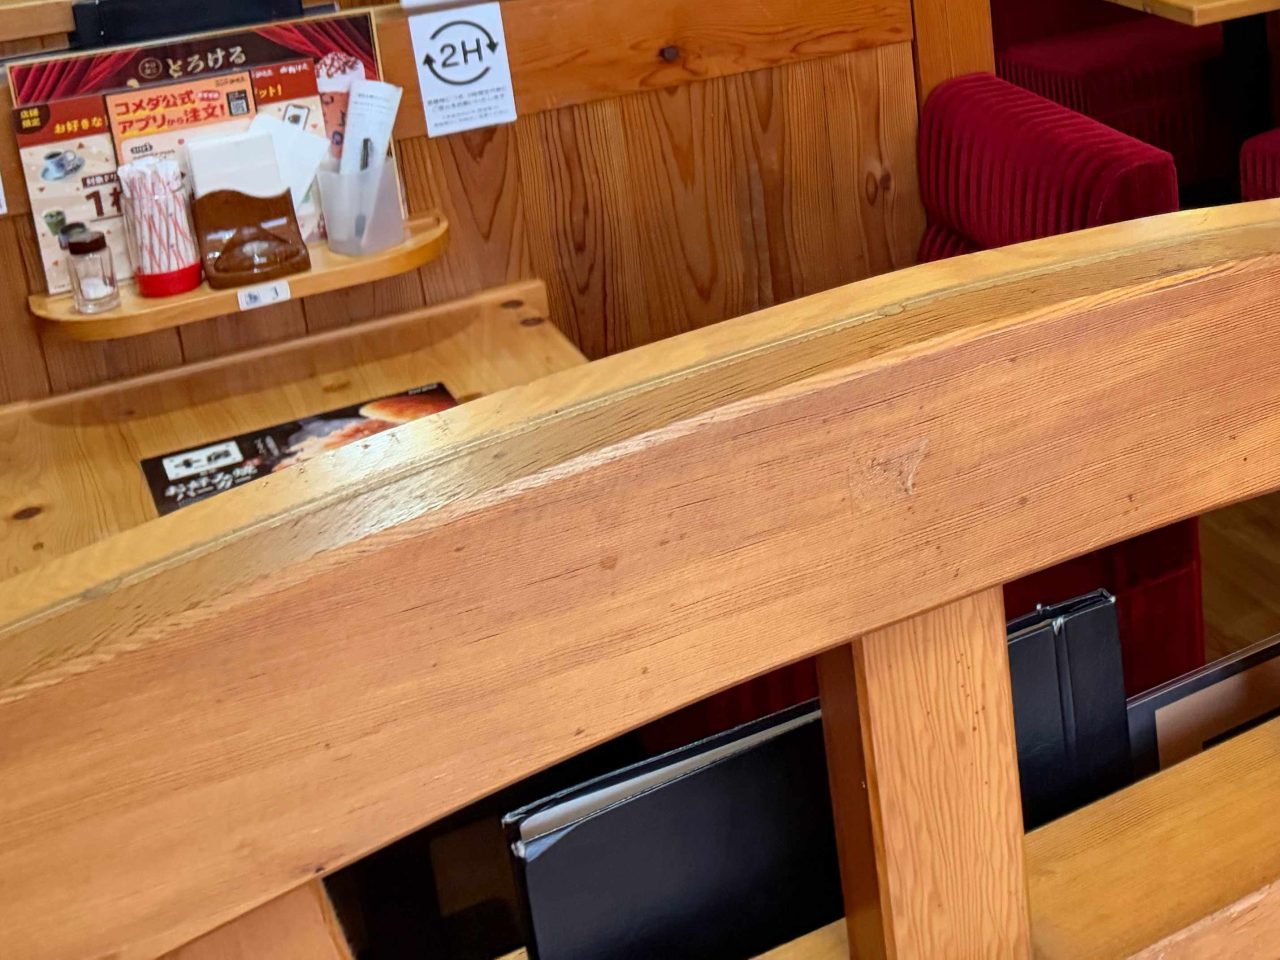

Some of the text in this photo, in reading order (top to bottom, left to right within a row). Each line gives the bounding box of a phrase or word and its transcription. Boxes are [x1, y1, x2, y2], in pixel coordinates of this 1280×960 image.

[167, 45, 247, 79] とろける
[439, 38, 483, 69] 2H
[114, 90, 196, 117] コメダ公式
[54, 116, 107, 135] お好きな
[117, 103, 226, 136] アプリから注文!
